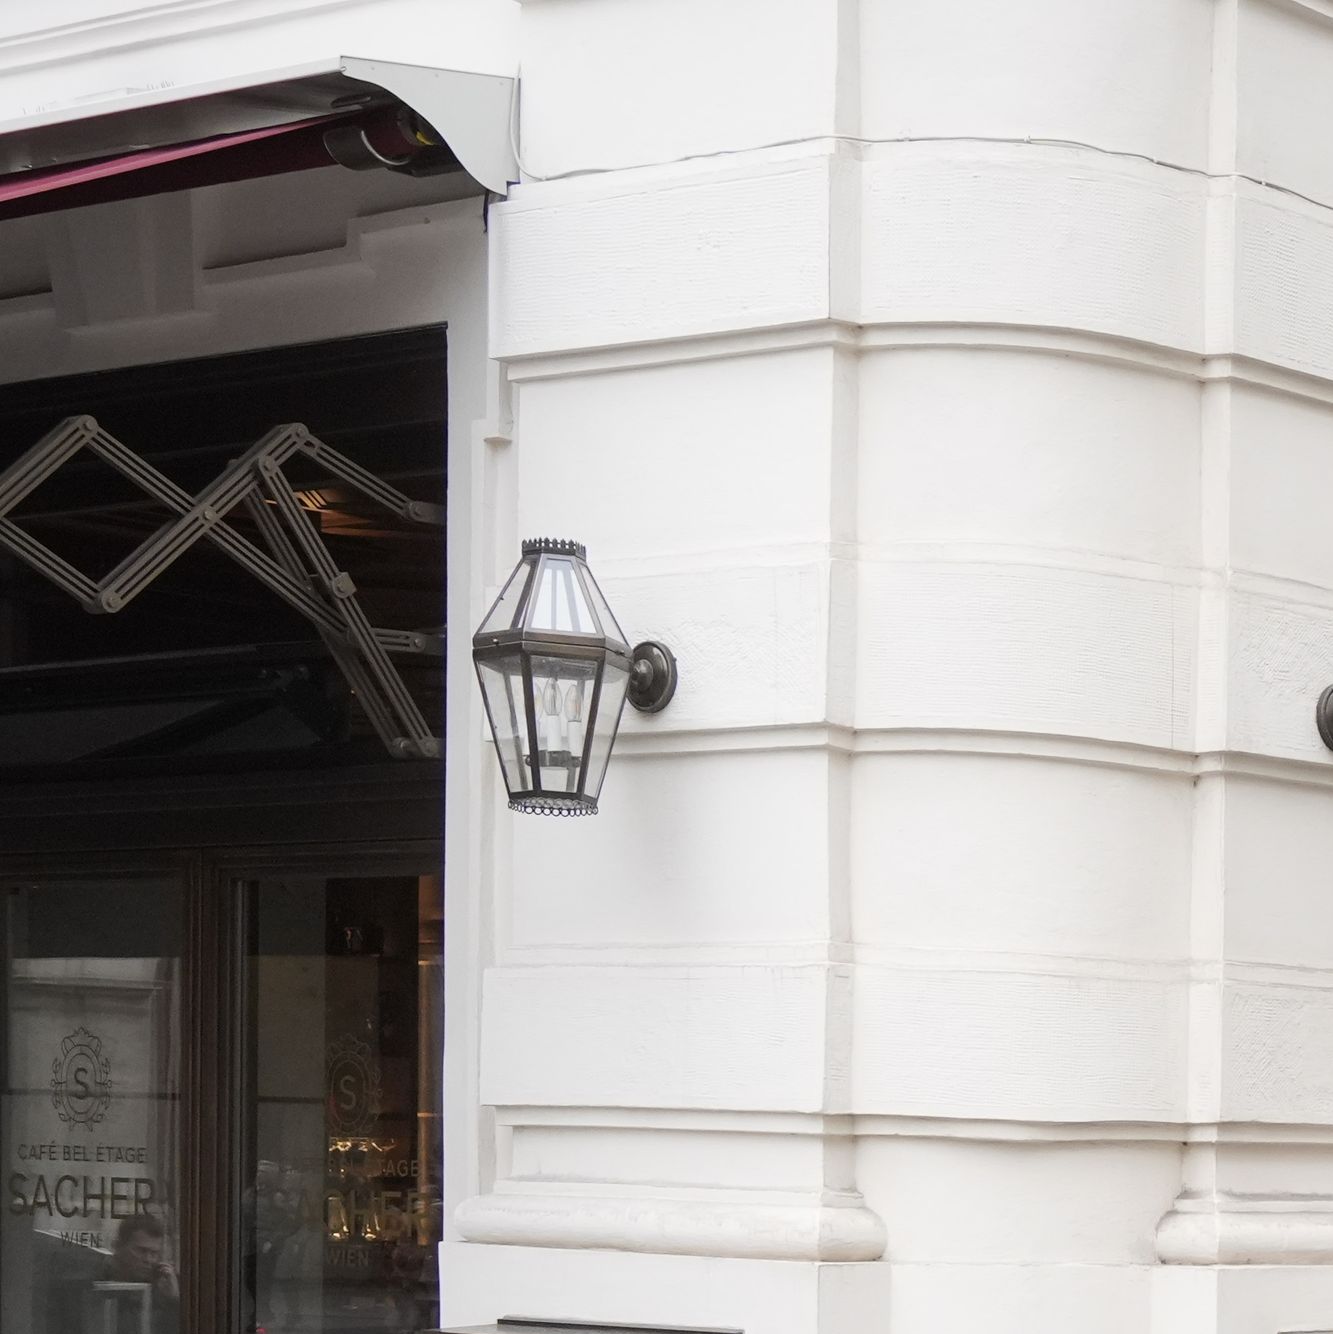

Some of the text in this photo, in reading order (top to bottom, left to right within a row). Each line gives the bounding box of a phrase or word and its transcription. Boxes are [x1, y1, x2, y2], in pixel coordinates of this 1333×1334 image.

[17, 1140, 58, 1162] CAFÉ
[62, 1145, 93, 1163] BEL
[7, 1172, 156, 1220] SACHER
[60, 1230, 101, 1249] WIEN
[325, 1247, 369, 1268] WIEN
